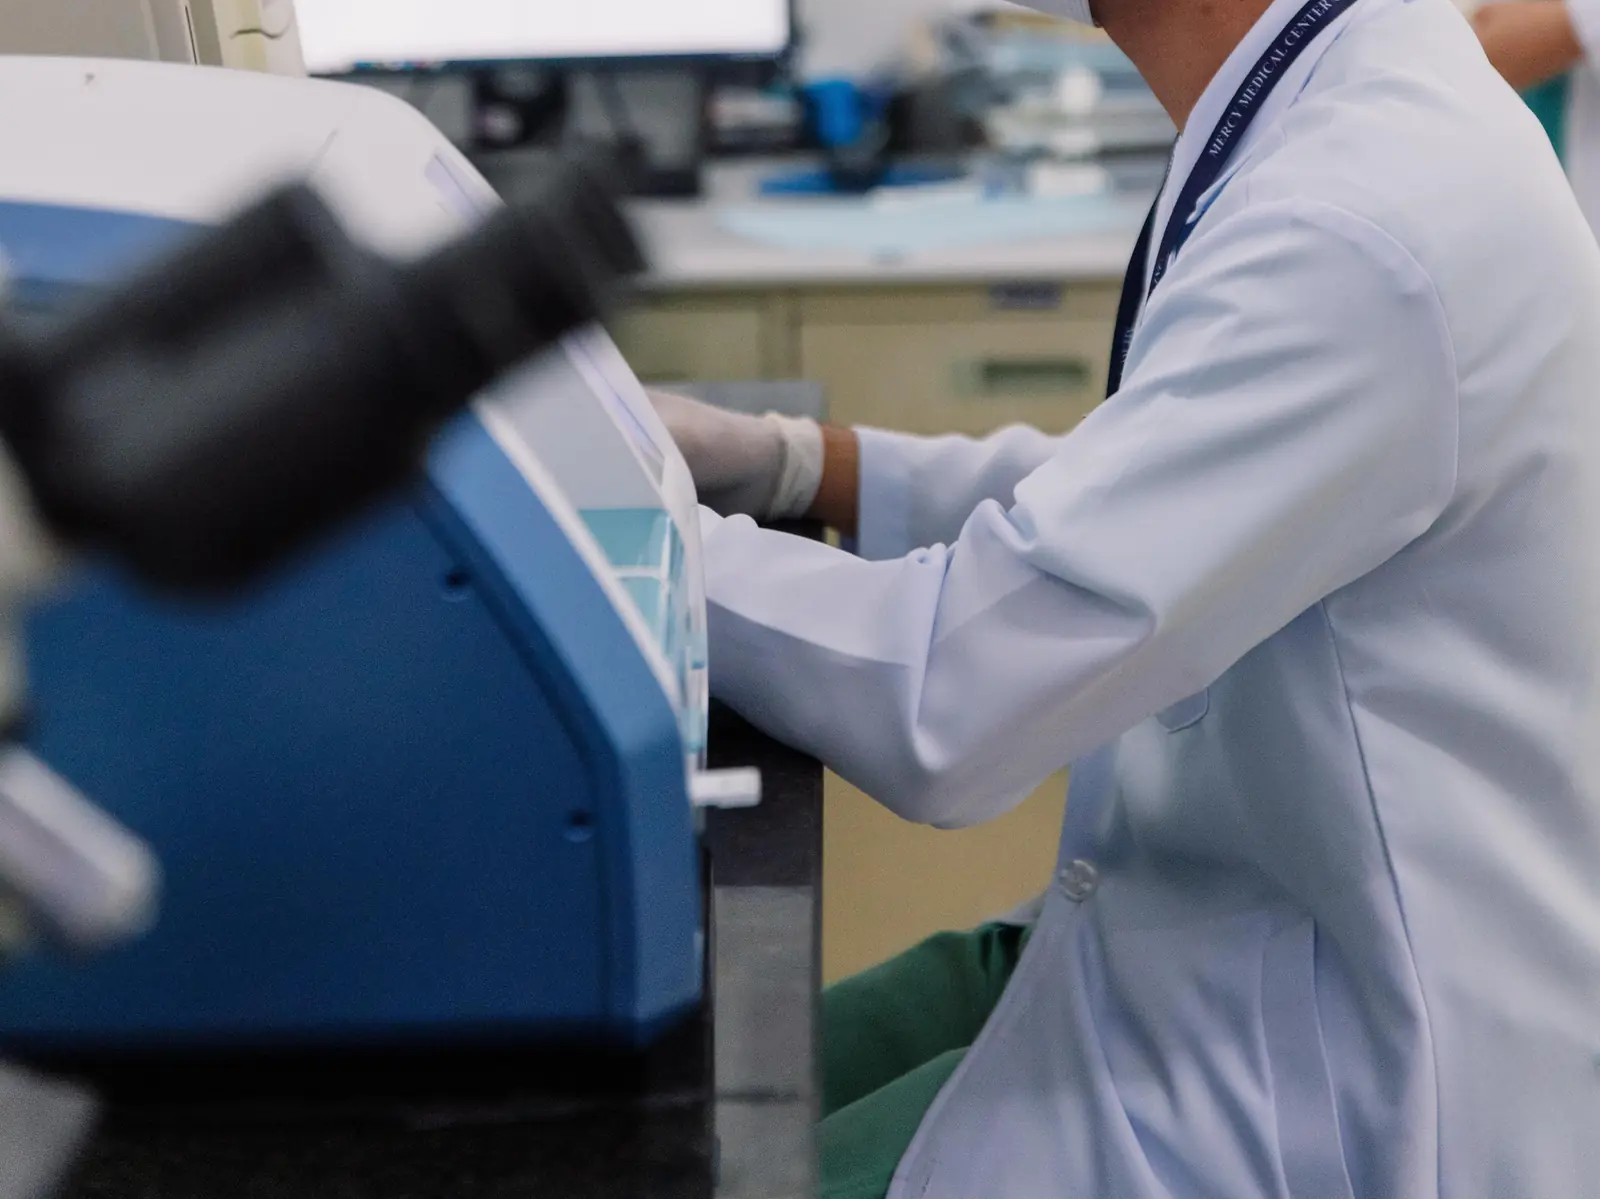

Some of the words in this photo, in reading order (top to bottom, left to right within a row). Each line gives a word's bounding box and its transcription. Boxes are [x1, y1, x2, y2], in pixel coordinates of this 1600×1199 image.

[1209, 107, 1243, 158] MERCY
[1238, 48, 1288, 108] MEDICAL
[1284, 0, 1333, 46] CENTER
